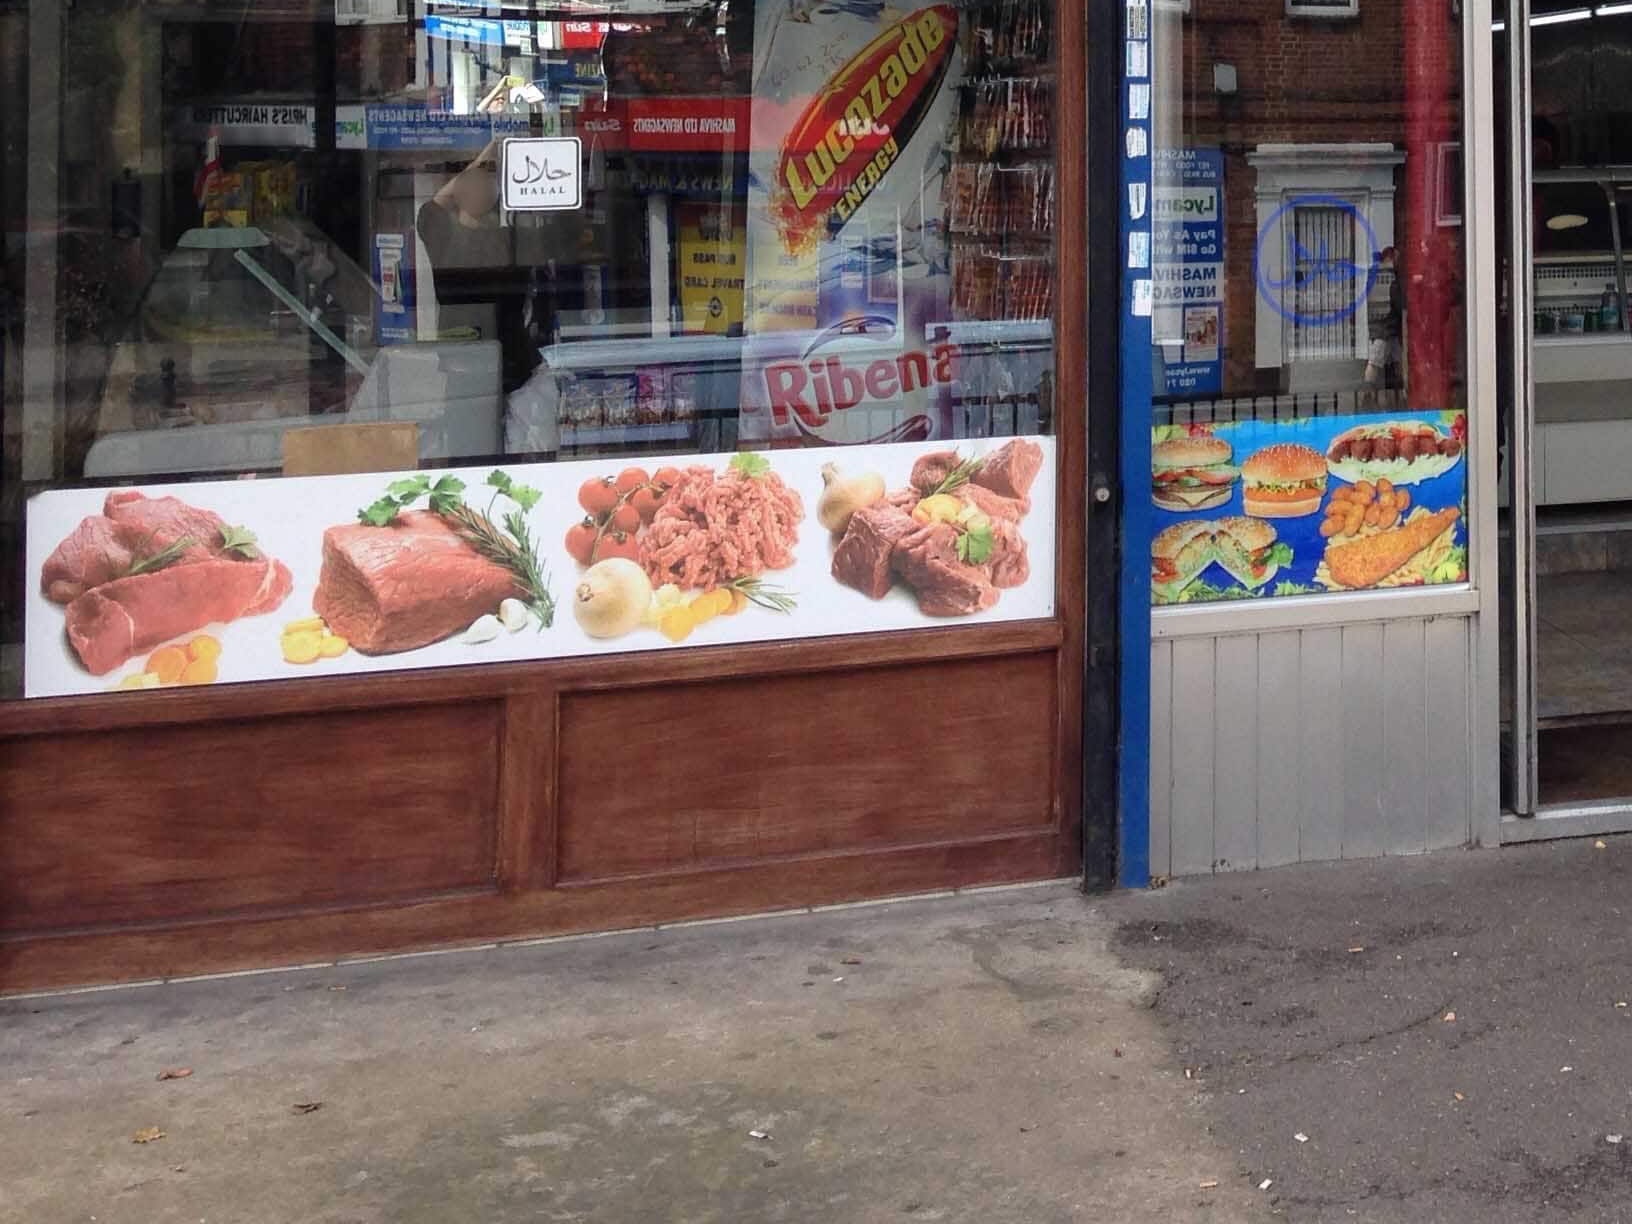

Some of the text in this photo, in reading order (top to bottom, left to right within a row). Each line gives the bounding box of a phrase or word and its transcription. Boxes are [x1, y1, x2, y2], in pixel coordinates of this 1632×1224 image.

[786, 9, 945, 212] Lucozade
[511, 155, 572, 184] حلال
[520, 187, 566, 195] HALAL
[835, 136, 898, 219] ENERGY
[764, 342, 961, 429] Ribena
